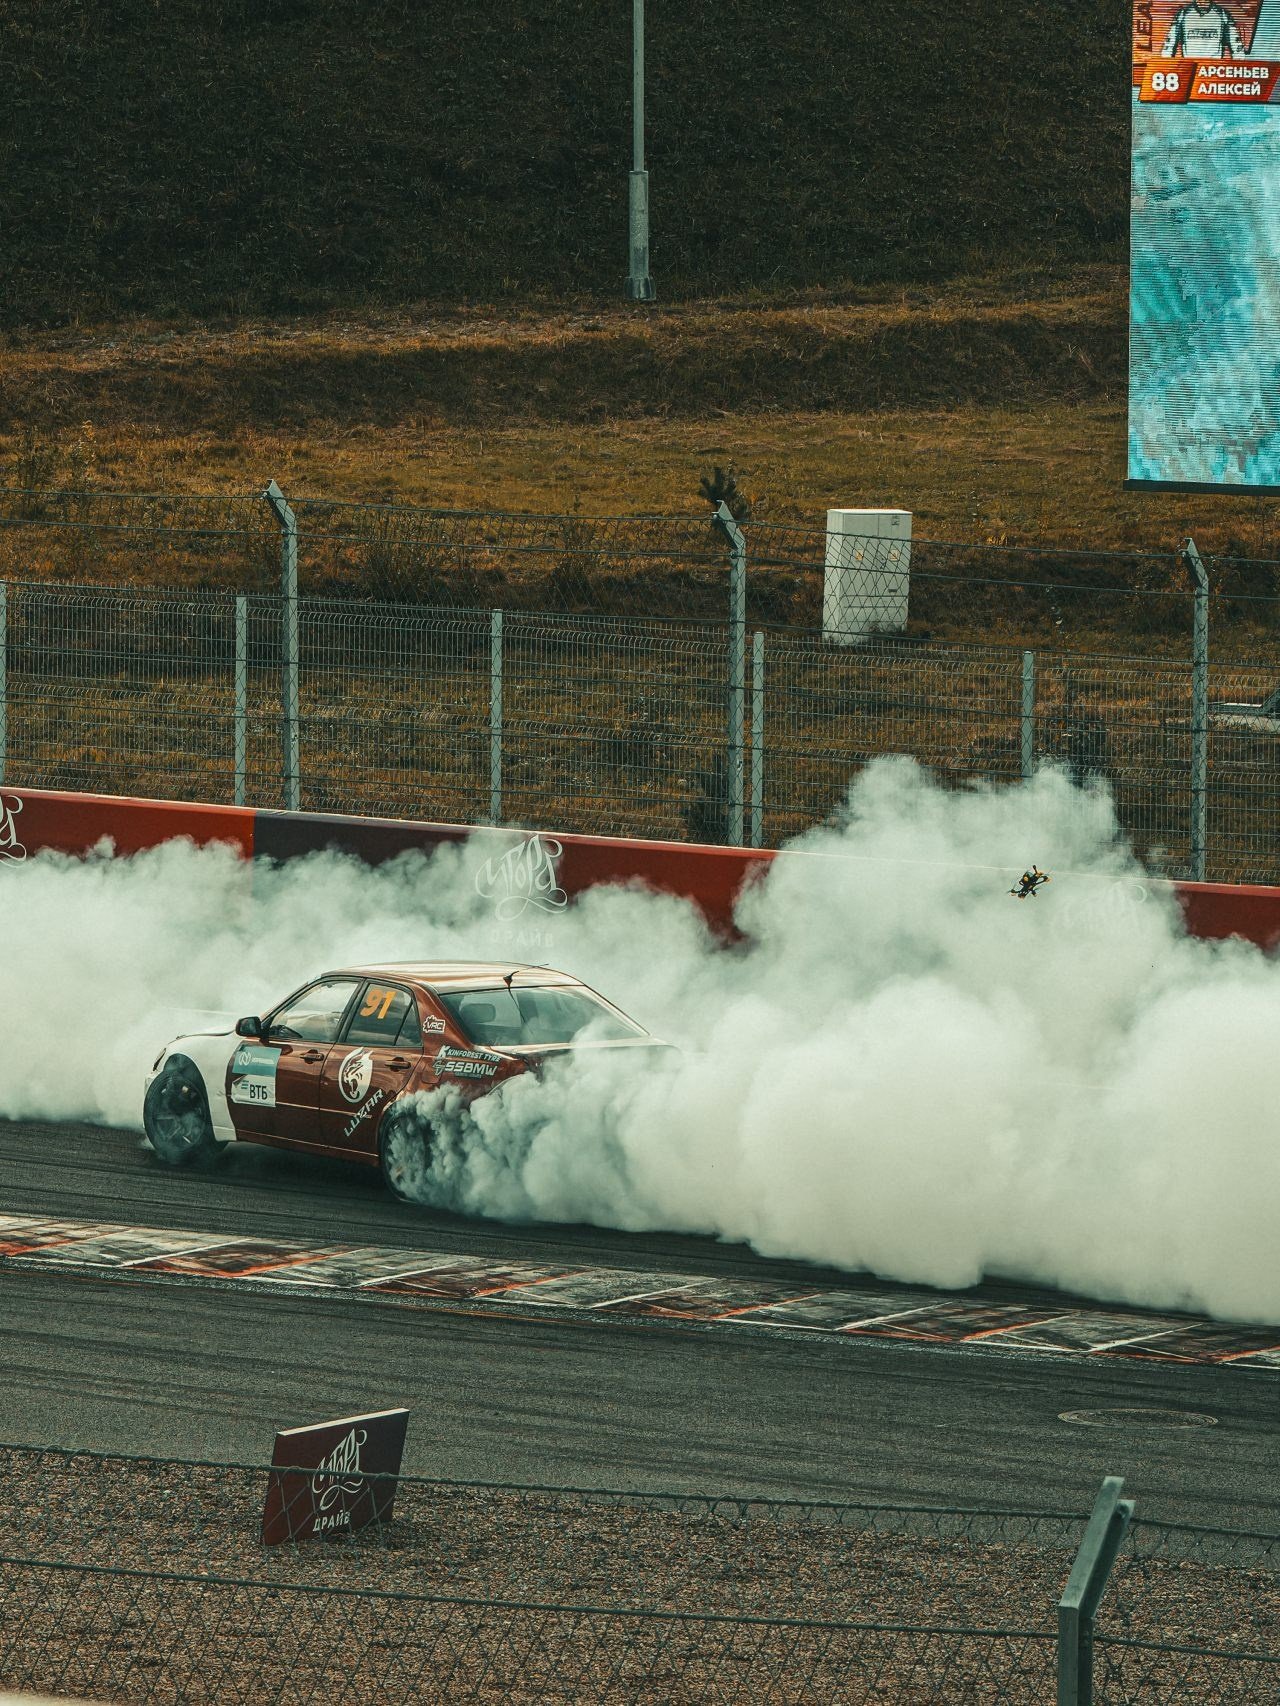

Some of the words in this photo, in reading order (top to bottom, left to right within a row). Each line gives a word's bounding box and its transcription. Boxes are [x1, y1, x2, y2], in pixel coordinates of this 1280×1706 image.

[1198, 66, 1269, 79] АРСЕНЬЕВ
[1151, 72, 1179, 91] 88
[1198, 82, 1261, 95] АЛЕКСЕЙ
[360, 989, 396, 1019] 91
[427, 1021, 443, 1029] VRC
[447, 1049, 482, 1059] KINFOREST
[484, 1054, 501, 1062] TYRE
[445, 1061, 498, 1076] SSBMW
[250, 1084, 268, 1100] ВТБ
[344, 1088, 384, 1137] LUZAR
[312, 1510, 351, 1532] ДРАЙВ
